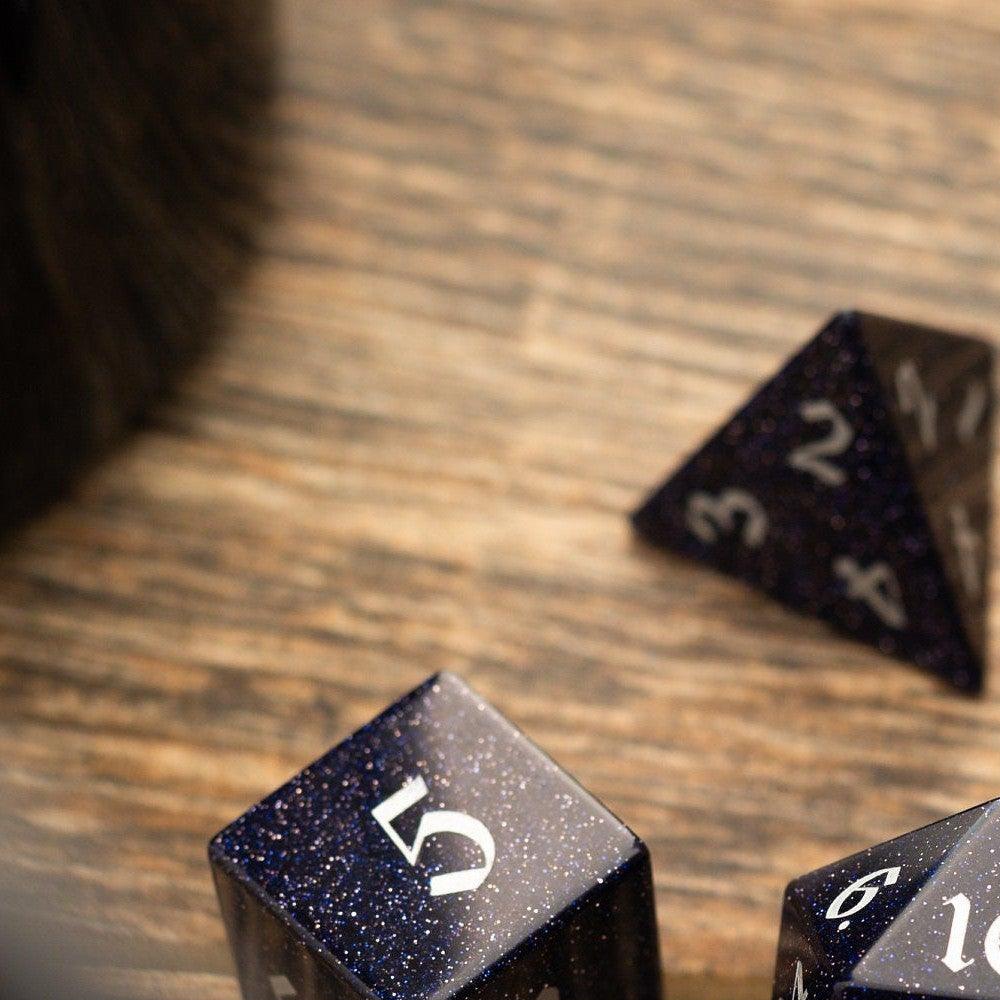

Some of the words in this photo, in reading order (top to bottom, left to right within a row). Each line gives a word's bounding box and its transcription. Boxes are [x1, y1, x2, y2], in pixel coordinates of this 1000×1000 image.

[788, 400, 854, 487] 2
[686, 488, 768, 546] 3
[370, 774, 496, 896] 5
